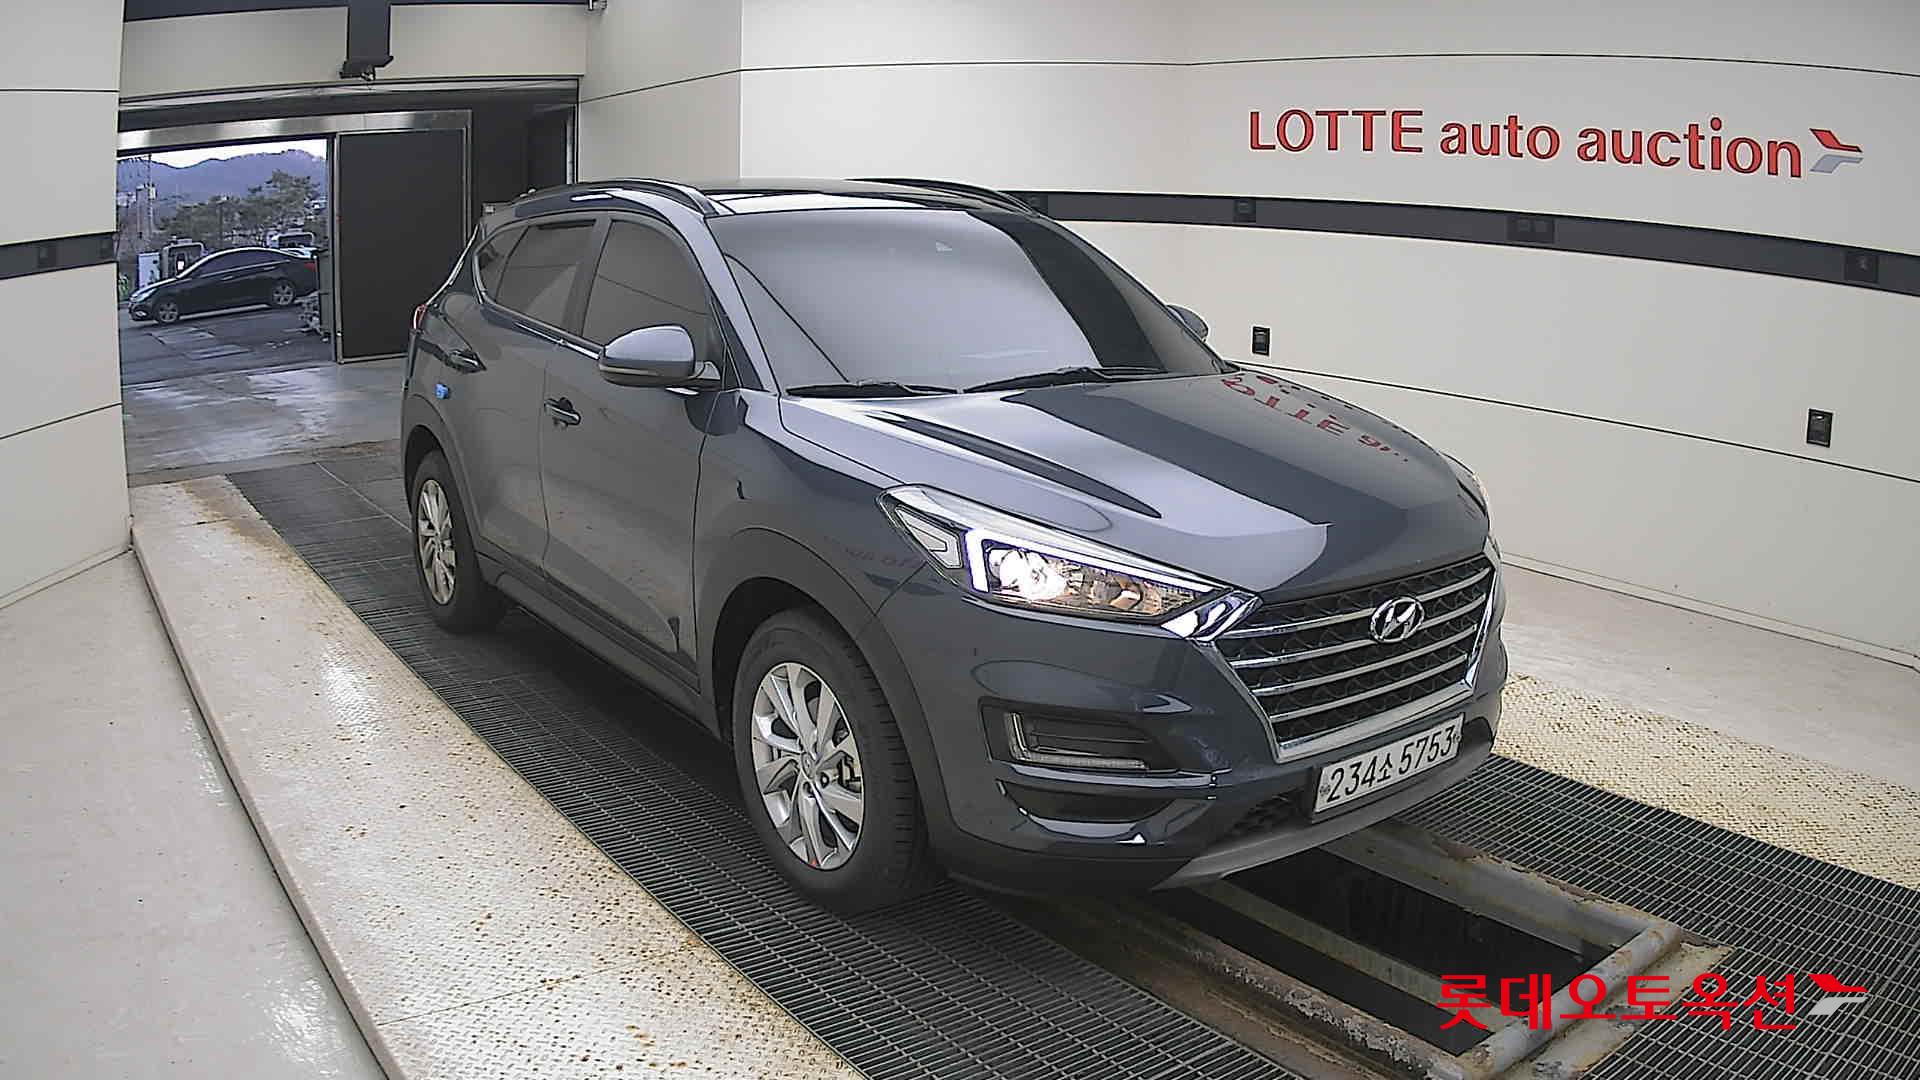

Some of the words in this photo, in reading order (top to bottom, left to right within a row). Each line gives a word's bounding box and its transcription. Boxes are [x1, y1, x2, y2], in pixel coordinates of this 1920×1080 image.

[1249, 109, 1424, 153] LOTTE
[1440, 115, 1561, 160] auto
[1577, 117, 1803, 178] auction
[1399, 725, 1455, 774] 5753
